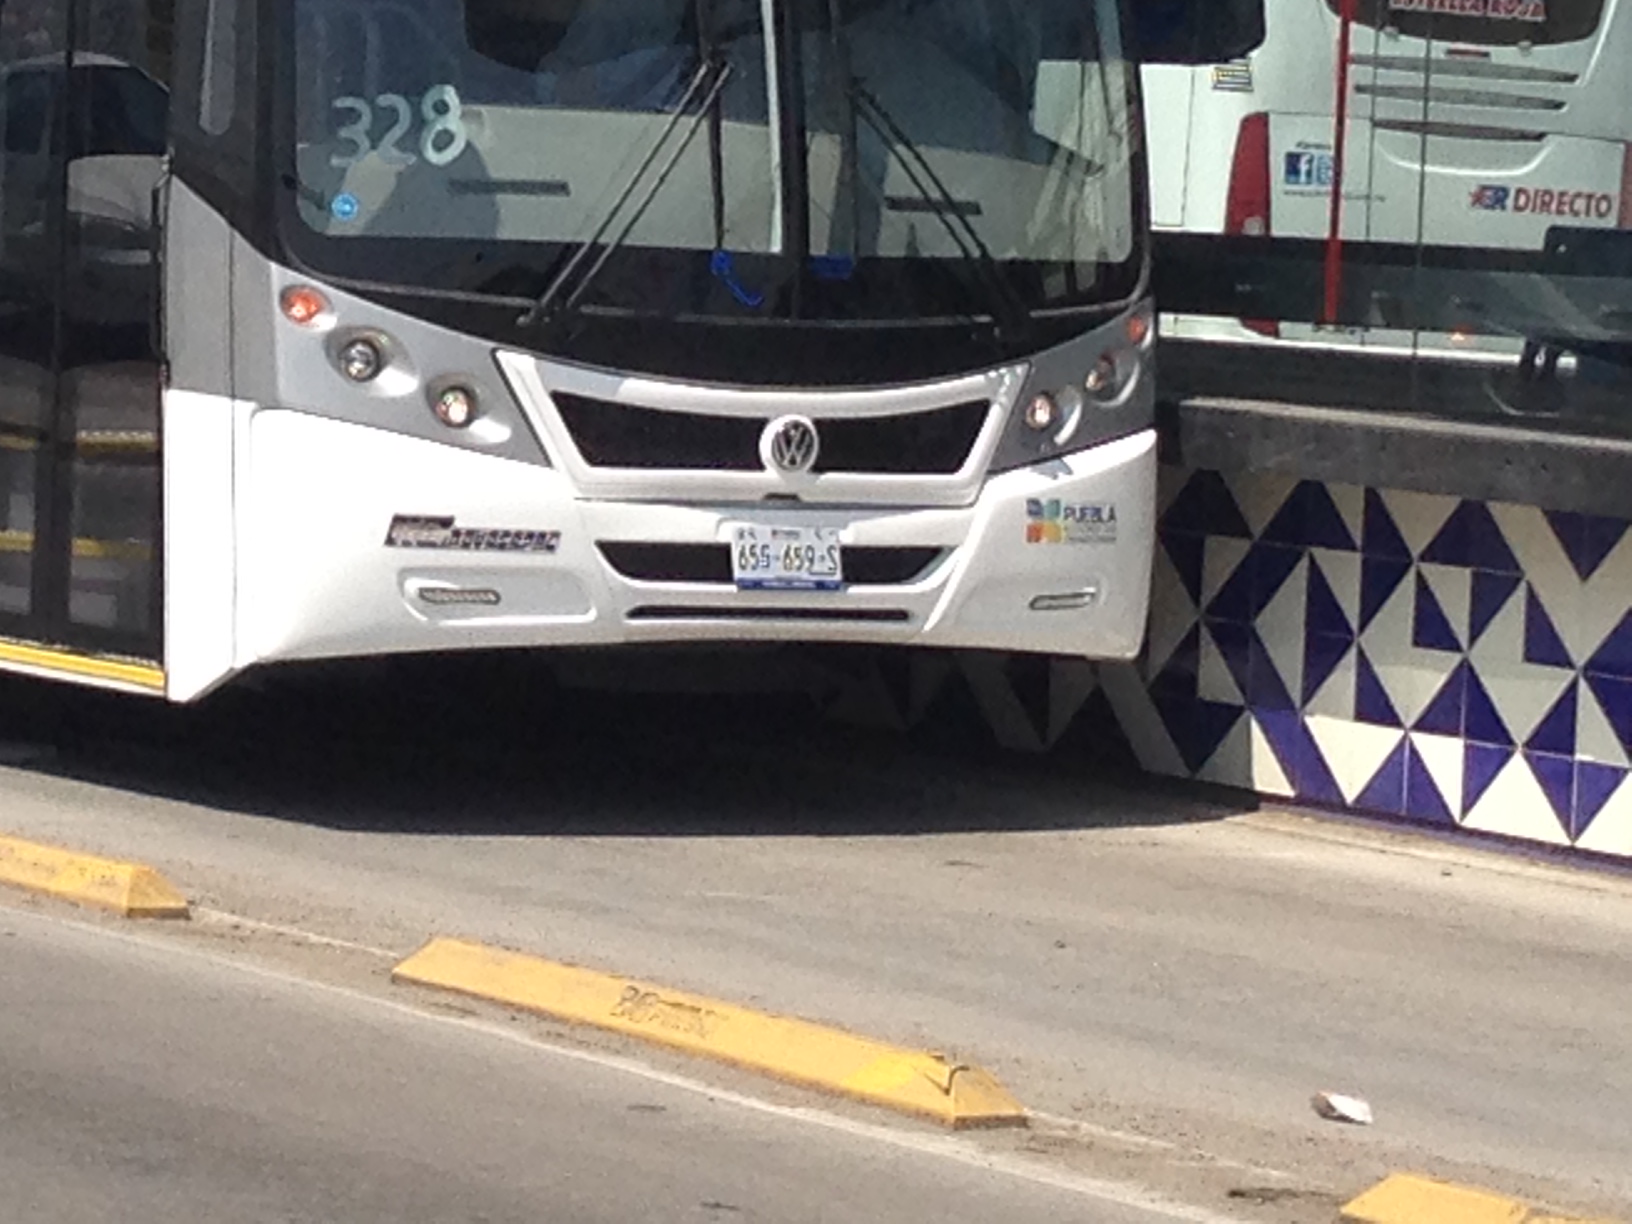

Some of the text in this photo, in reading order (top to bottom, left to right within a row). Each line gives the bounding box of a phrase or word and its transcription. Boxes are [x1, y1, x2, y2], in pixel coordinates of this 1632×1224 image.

[330, 84, 467, 167] 328
[1513, 187, 1613, 218] DIRECTO
[1064, 506, 1117, 524] PUEBLA
